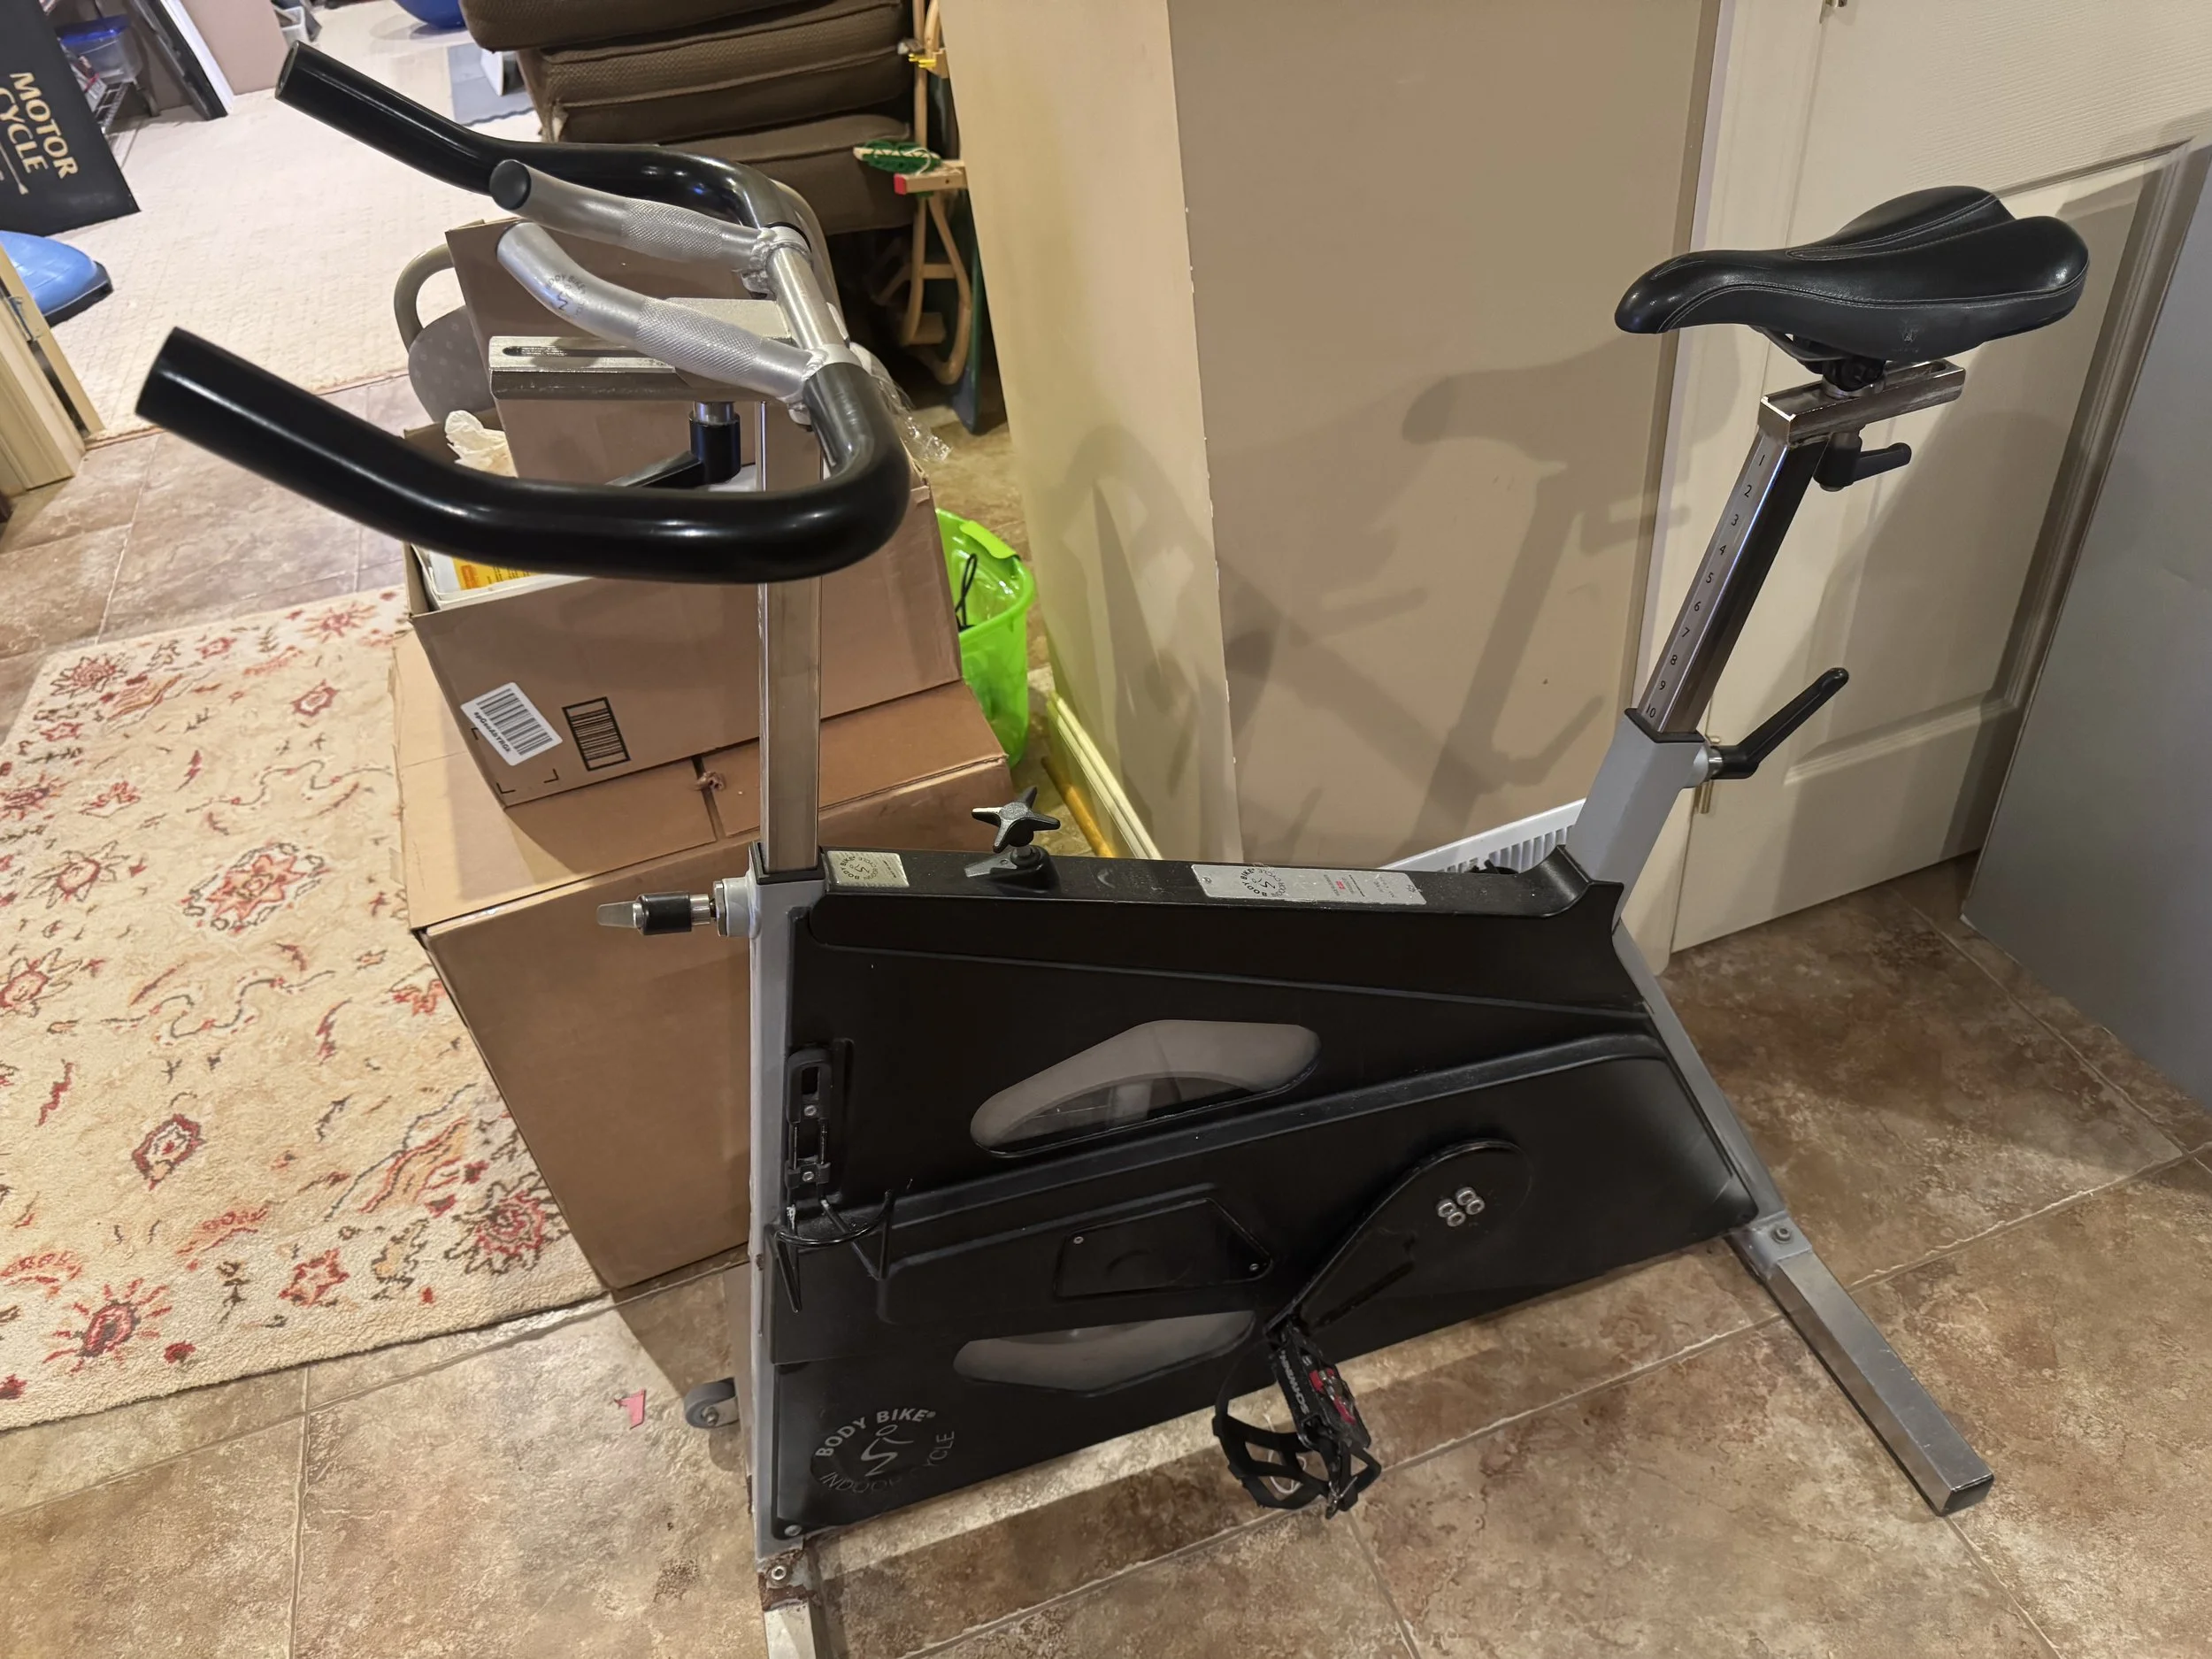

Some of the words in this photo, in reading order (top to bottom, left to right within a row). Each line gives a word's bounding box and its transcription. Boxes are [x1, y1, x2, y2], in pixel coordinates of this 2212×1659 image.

[10, 72, 78, 179] MOTOR
[1758, 454, 1765, 466] 1
[1744, 484, 1752, 497] 2
[1731, 514, 1739, 526] 3
[1719, 544, 1727, 556] 4
[1705, 572, 1714, 584] 5
[1694, 601, 1701, 611] 6
[1682, 627, 1690, 638] 7
[1670, 655, 1678, 665] 8
[1659, 680, 1666, 691] 9
[1646, 703, 1656, 718] 10
[1240, 868, 1256, 880] BIKE
[1241, 881, 1268, 897] BODY
[1279, 1352, 1310, 1414] SCHWINN
[815, 1417, 866, 1457] BODY
[876, 1408, 929, 1423] BIKE
